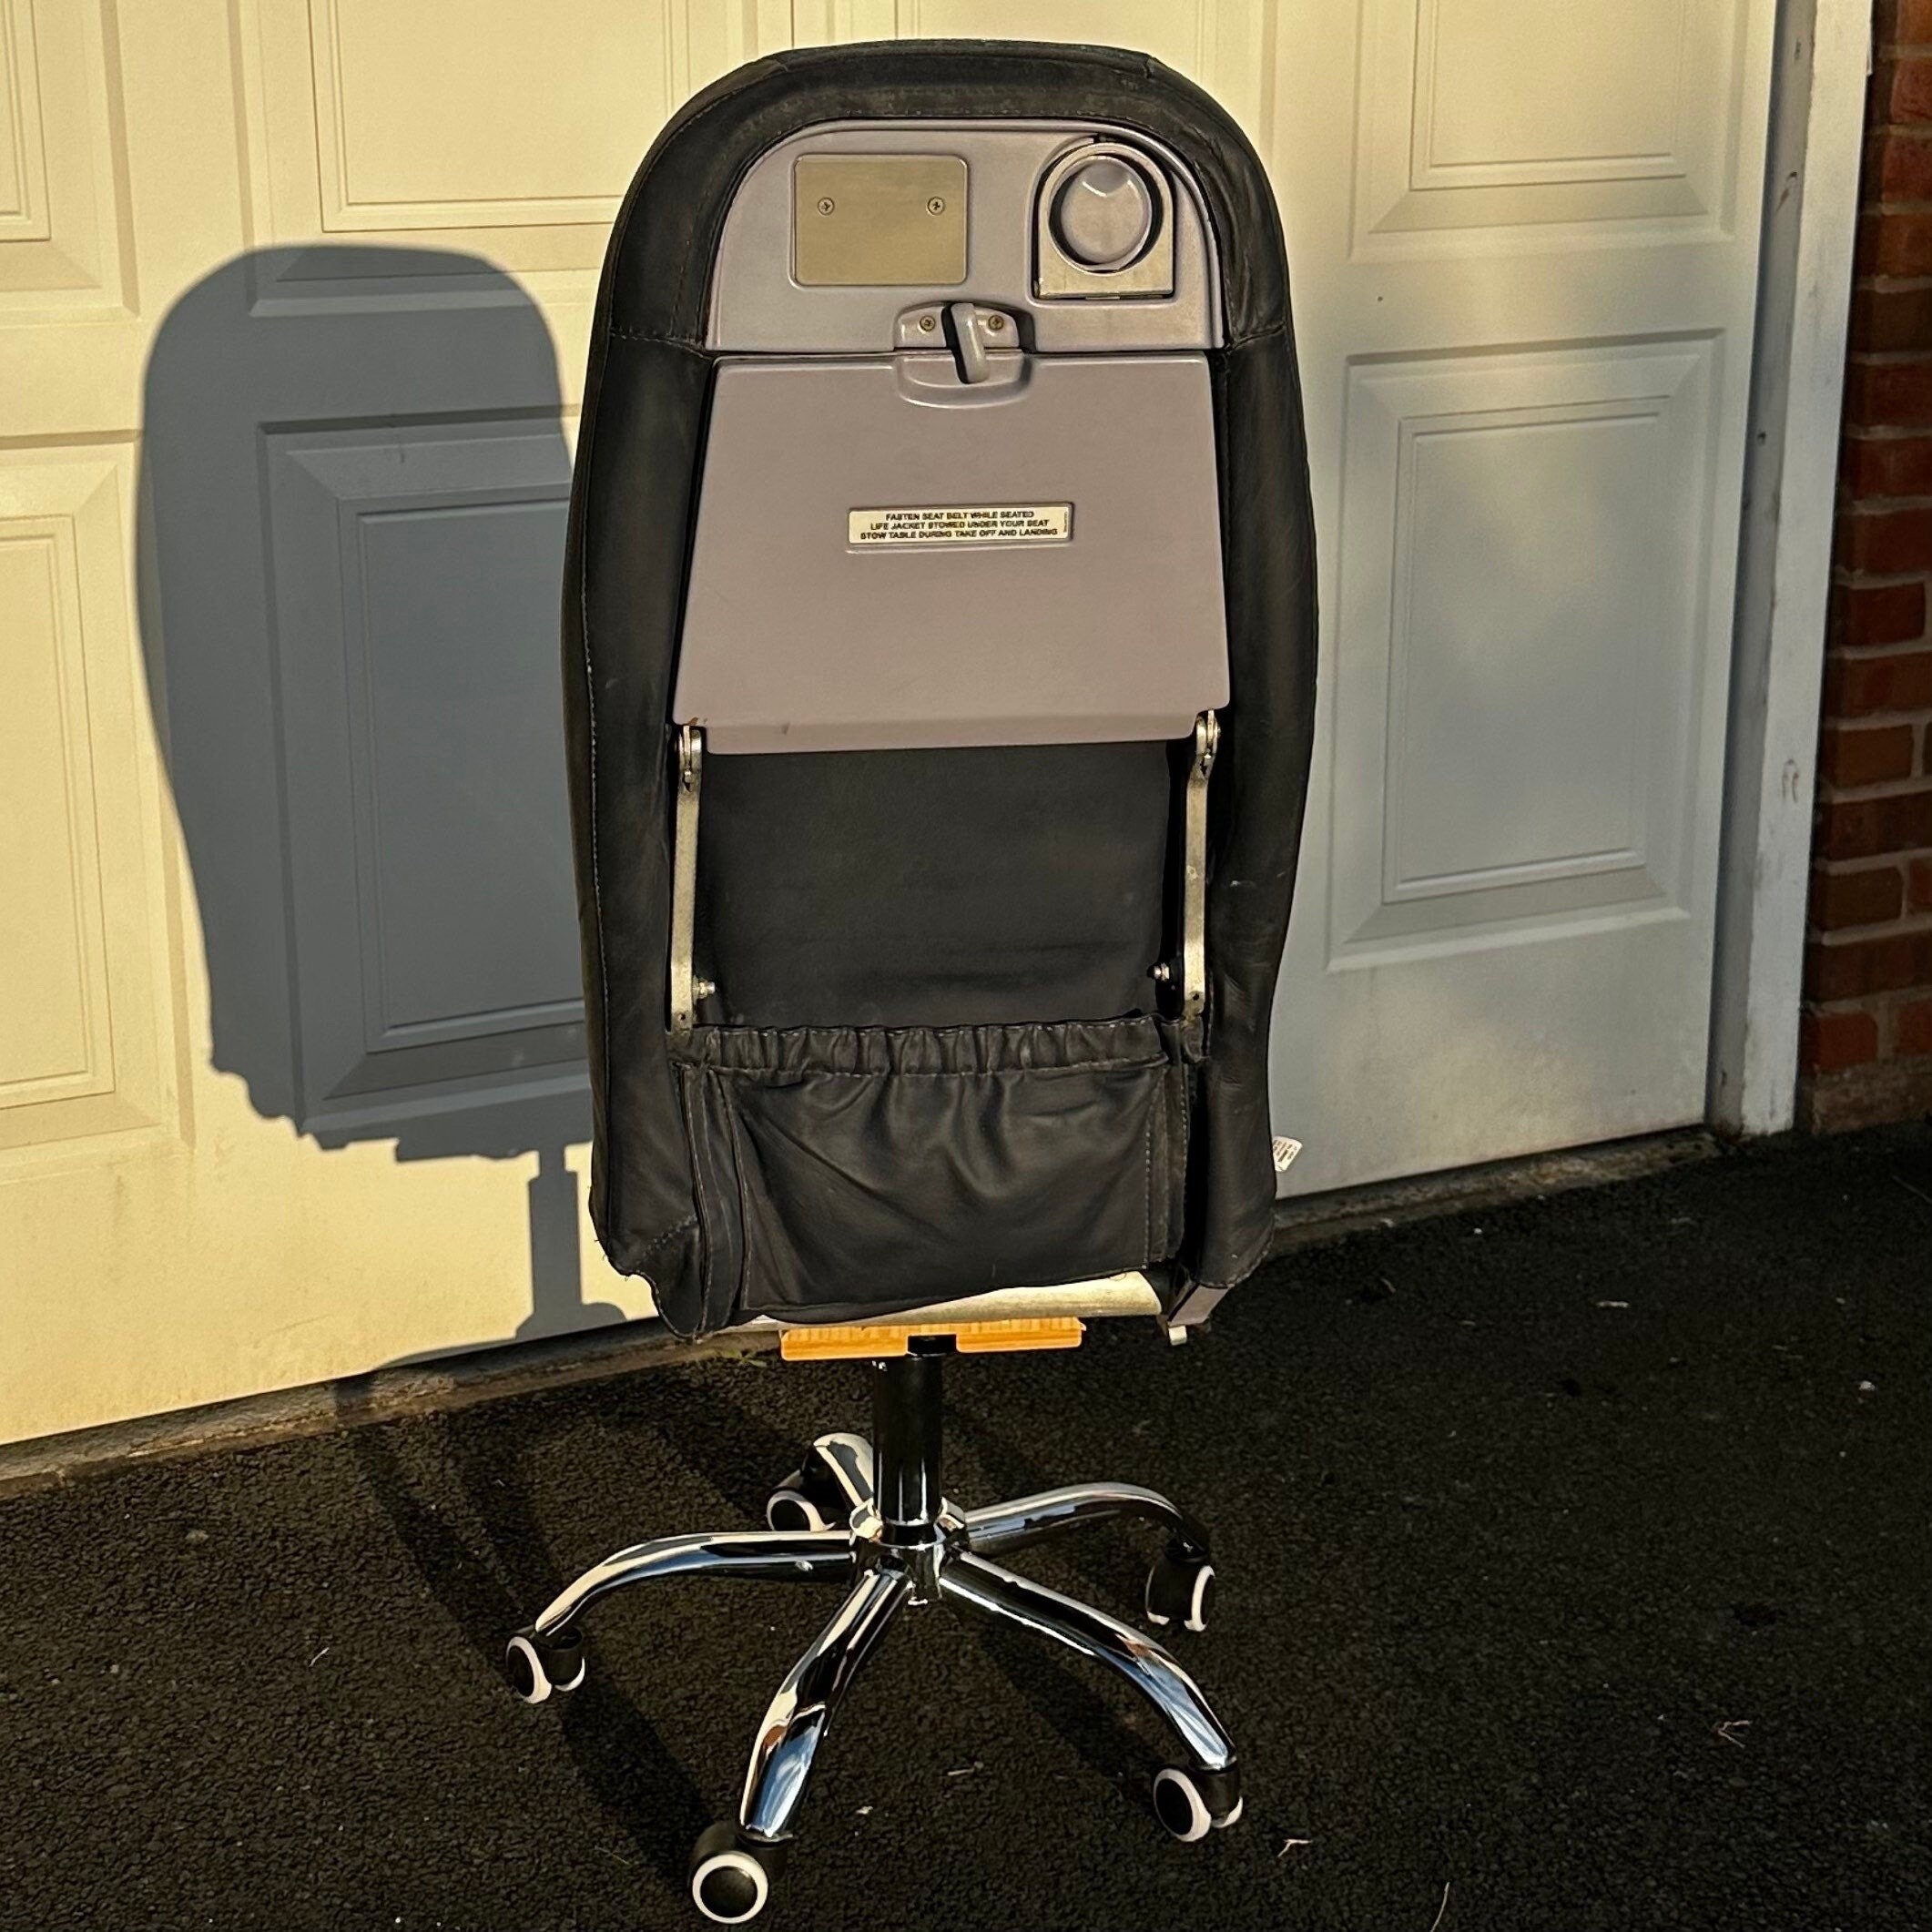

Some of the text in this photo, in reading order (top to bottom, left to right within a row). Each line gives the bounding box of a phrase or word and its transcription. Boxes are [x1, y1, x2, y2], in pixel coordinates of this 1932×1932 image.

[886, 513, 920, 521] FASTEN
[947, 512, 970, 520] BELT
[891, 522, 925, 530] JACKET
[980, 529, 996, 537] OFF
[1020, 528, 1057, 536] LANDING
